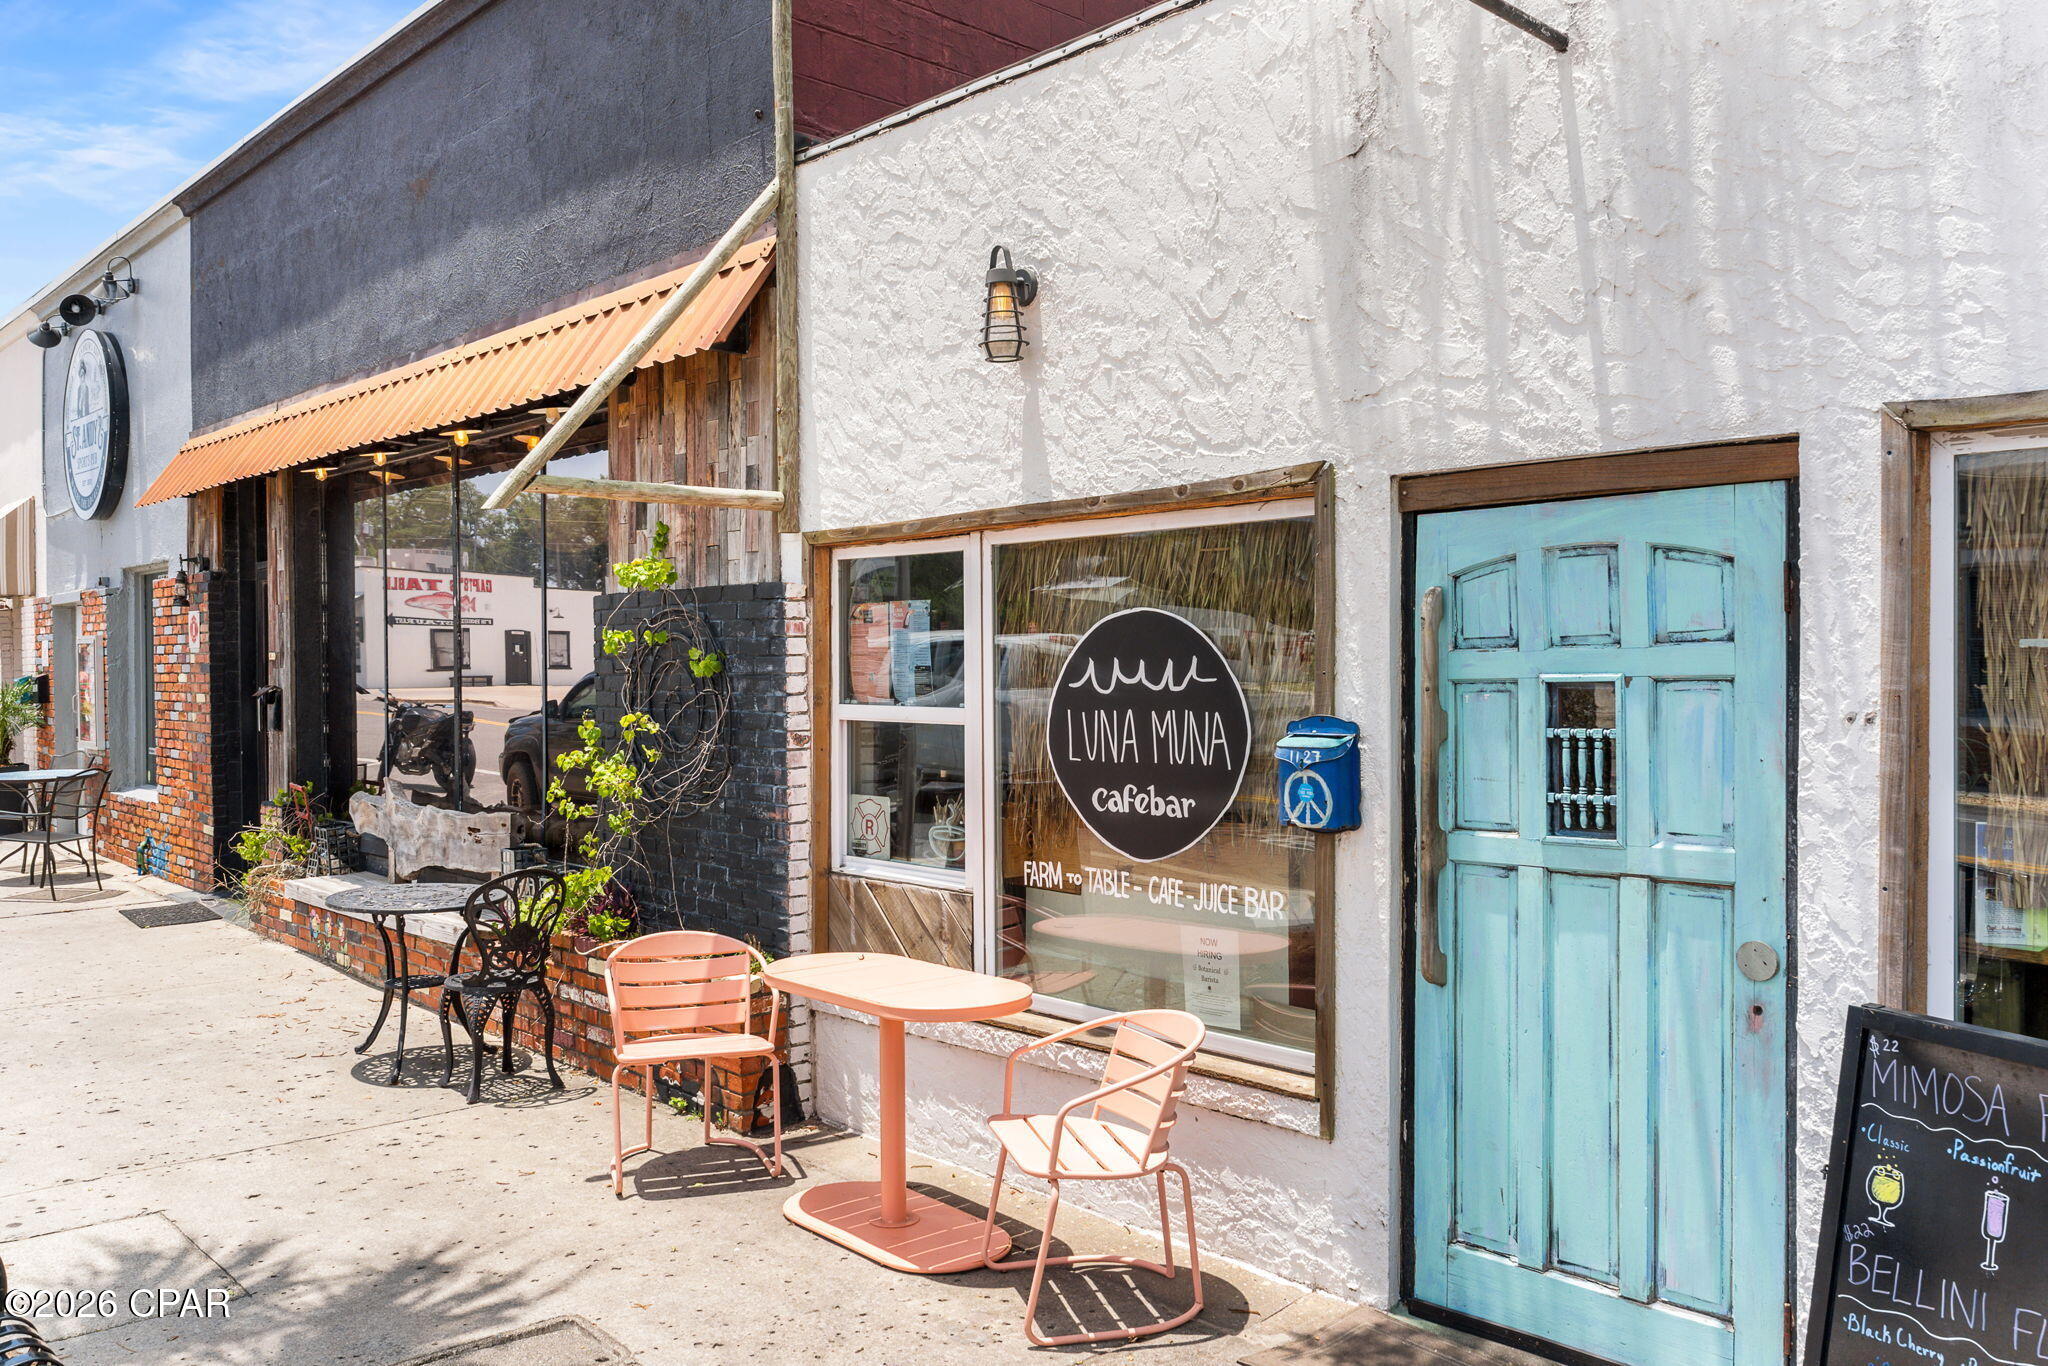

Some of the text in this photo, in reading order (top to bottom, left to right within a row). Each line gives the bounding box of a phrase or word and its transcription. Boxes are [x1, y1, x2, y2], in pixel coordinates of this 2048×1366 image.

[1067, 708, 1232, 771] LUNA MUNA
[1290, 750, 1322, 764] 1127
[1091, 783, 1196, 819] cafebar
[865, 819, 874, 835] R
[1023, 860, 1064, 890] FARM
[1243, 886, 1285, 921] BAR
[1197, 949, 1223, 961] HIRING
[1200, 937, 1219, 948] NOW
[1872, 1058, 2010, 1138] MIMOSA
[1848, 1243, 1987, 1332] BELLINI
[1896, 1327, 1945, 1366] Cherry
